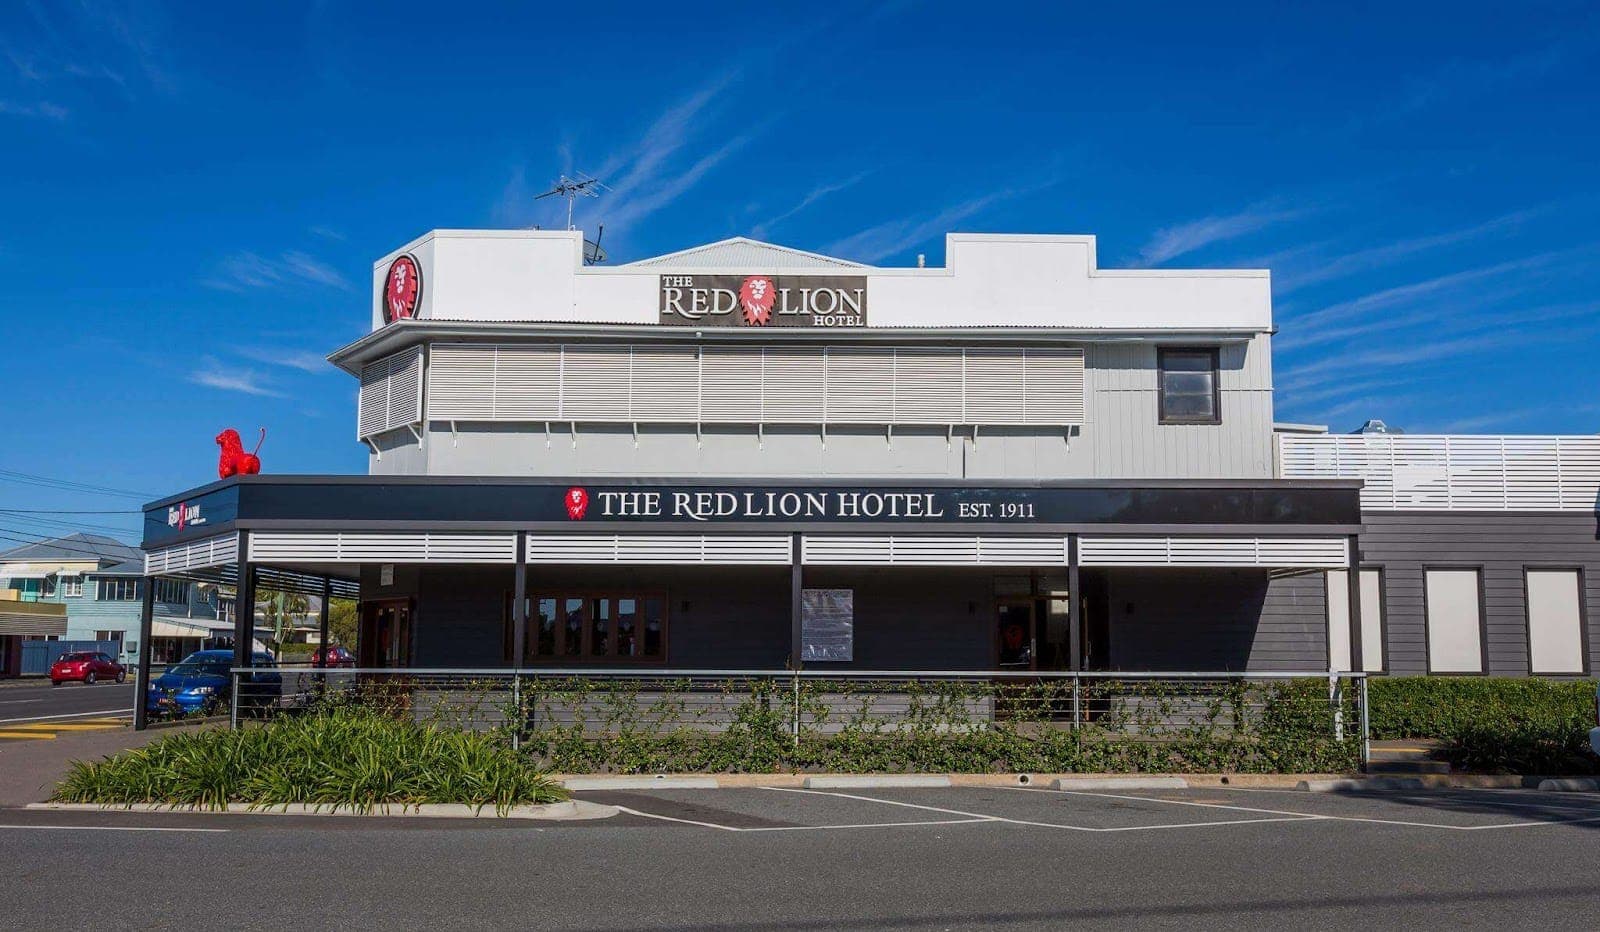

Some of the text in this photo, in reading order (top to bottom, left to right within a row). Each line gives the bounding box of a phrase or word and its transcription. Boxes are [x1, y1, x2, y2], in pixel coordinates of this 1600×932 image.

[663, 276, 693, 288] THE
[661, 287, 864, 319] RED LION
[814, 315, 864, 326] HOTEL
[598, 492, 1035, 521] THE RED LION HOTEL EST. 1911
